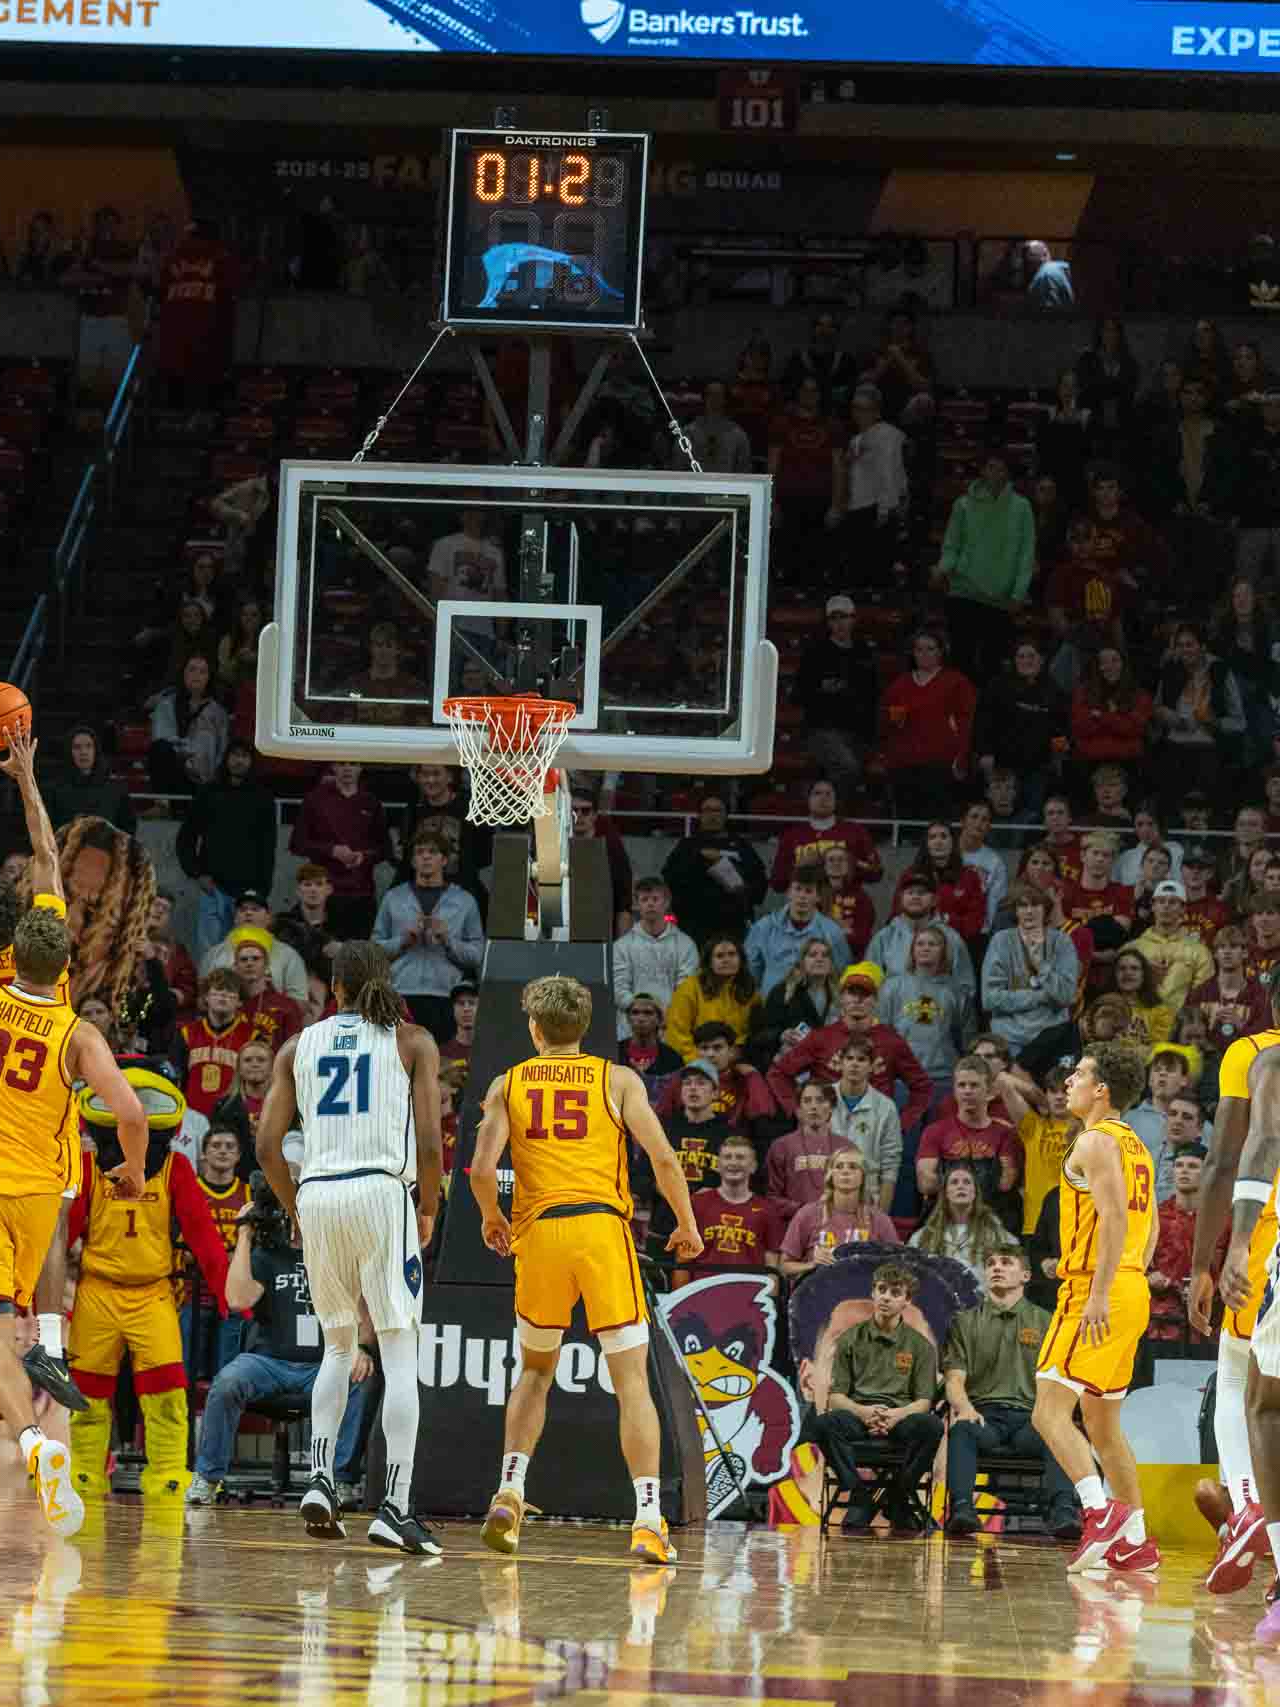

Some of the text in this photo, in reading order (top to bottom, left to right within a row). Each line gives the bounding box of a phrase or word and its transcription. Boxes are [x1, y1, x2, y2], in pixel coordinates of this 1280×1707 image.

[729, 97, 785, 129] 101
[504, 135, 598, 147] DAKTRONICS
[288, 726, 336, 738] SPALDING
[317, 1053, 371, 1116] 21
[525, 1088, 589, 1141] 15
[1127, 1161, 1150, 1212] 13
[125, 1209, 138, 1238] 1
[703, 1224, 757, 1247] STATE
